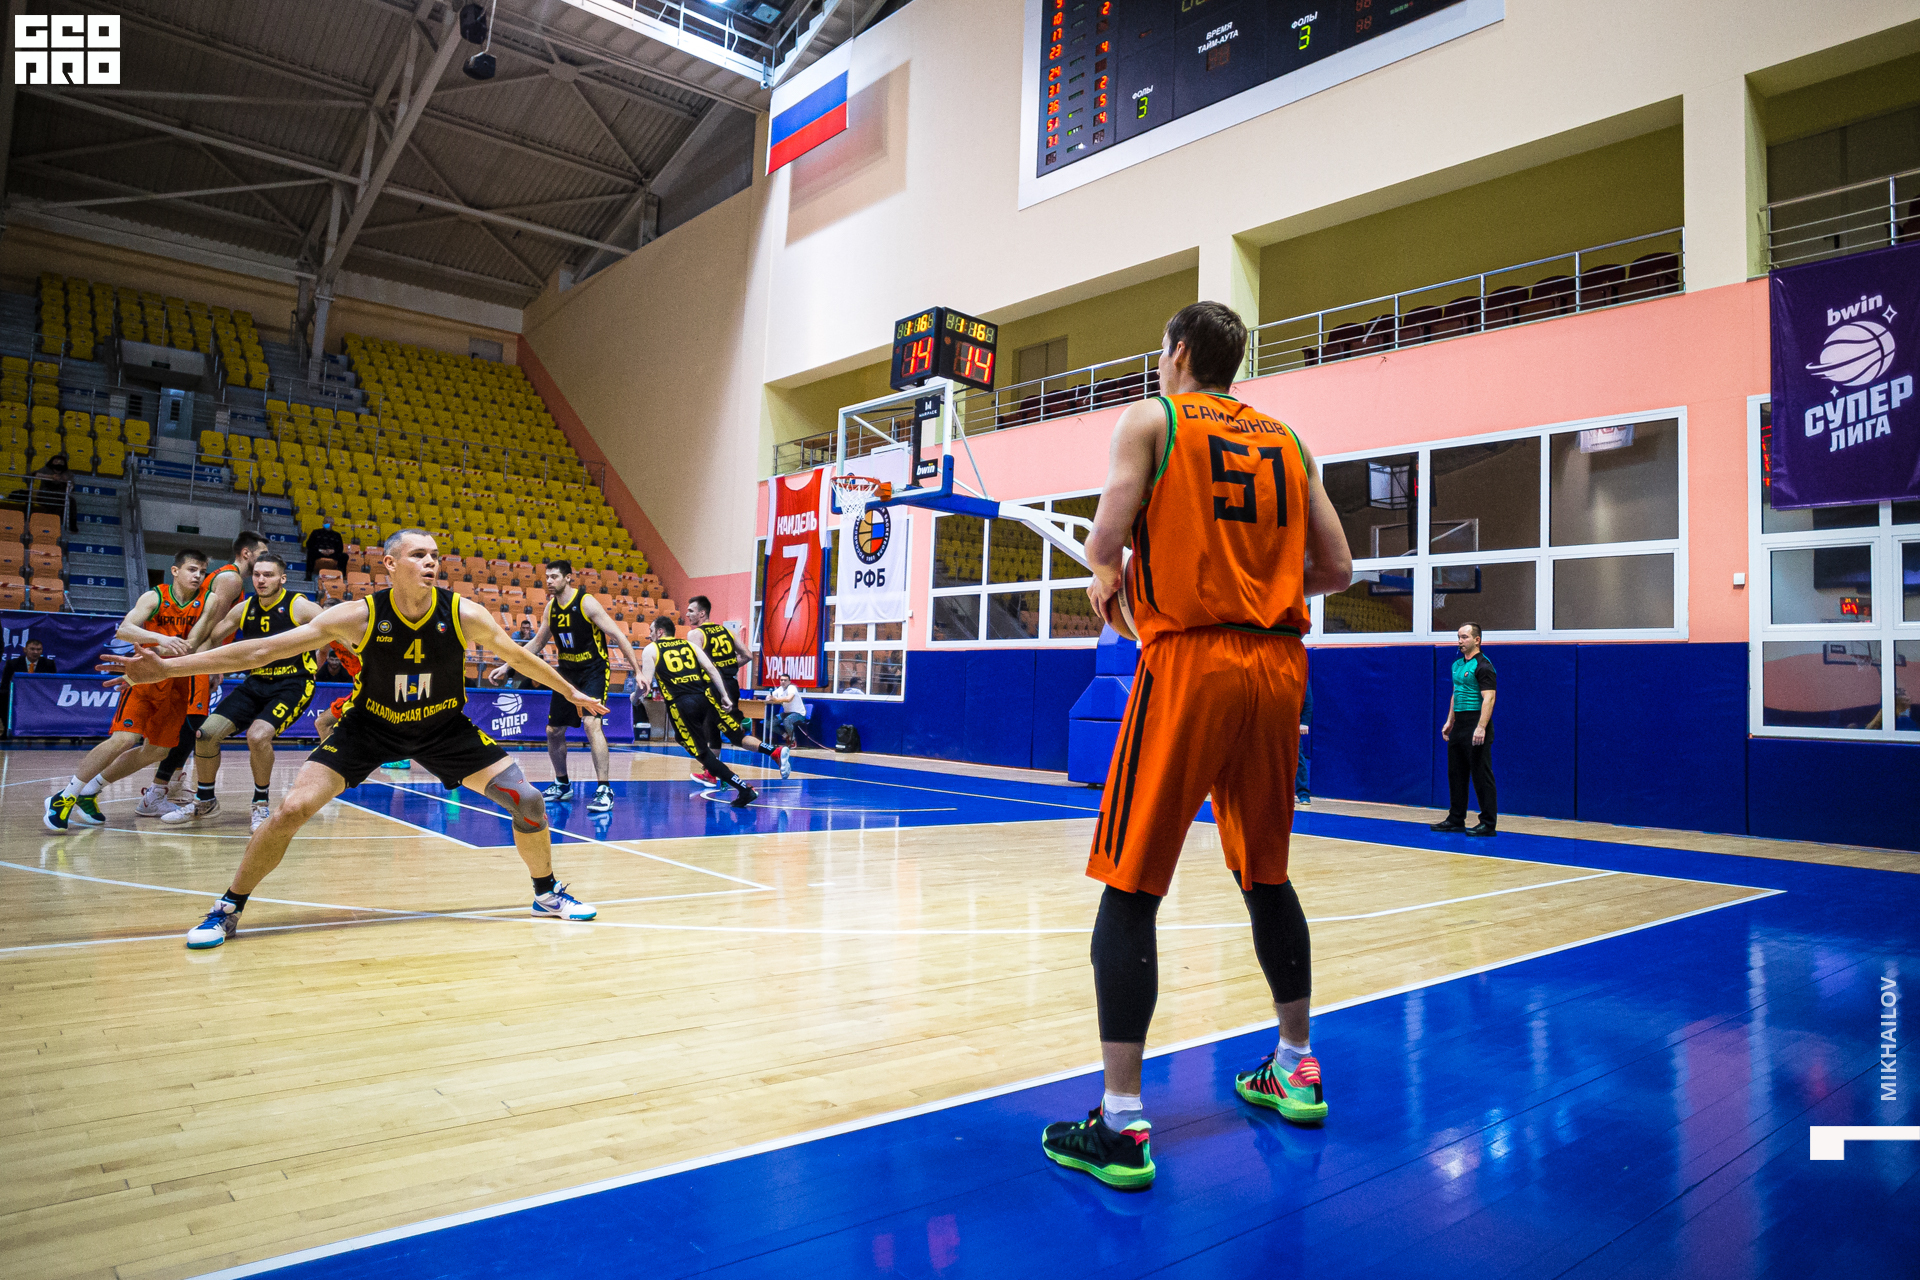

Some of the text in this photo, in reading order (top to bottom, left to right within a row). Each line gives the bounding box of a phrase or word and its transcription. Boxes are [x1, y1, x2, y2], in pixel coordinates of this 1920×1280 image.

[1206, 21, 1233, 40] ВРЕМЯ
[1291, 11, 1318, 29] ФОЛЫ
[1197, 29, 1239, 53] ТАЙМ-АУТА
[1299, 25, 1311, 50] 3
[1132, 84, 1154, 100] ФОЛЫ
[1137, 98, 1147, 119] 3
[1827, 294, 1883, 327] bwin
[909, 336, 933, 375] 14
[964, 345, 994, 384] 14
[1805, 374, 1913, 438] СУПЕР
[1829, 414, 1891, 453] ЛИГА
[916, 463, 936, 476] bwin
[777, 510, 817, 537] КАНДЕЛЬ
[782, 543, 808, 619] 7
[854, 568, 886, 589] РФБ
[260, 616, 270, 633] 5
[557, 613, 570, 627] 21
[403, 638, 425, 664] 4
[710, 634, 733, 657] 25
[663, 646, 696, 673] 63
[765, 655, 815, 680] УРАЛМАШ
[57, 684, 121, 708] bwi
[272, 702, 289, 719] 5
[365, 697, 458, 724] САХАЛИНСКАЯ ОБЛАСТЬ
[492, 713, 528, 731] СУПЕР
[477, 729, 498, 746] 4
[501, 727, 521, 737] ЛИГА
